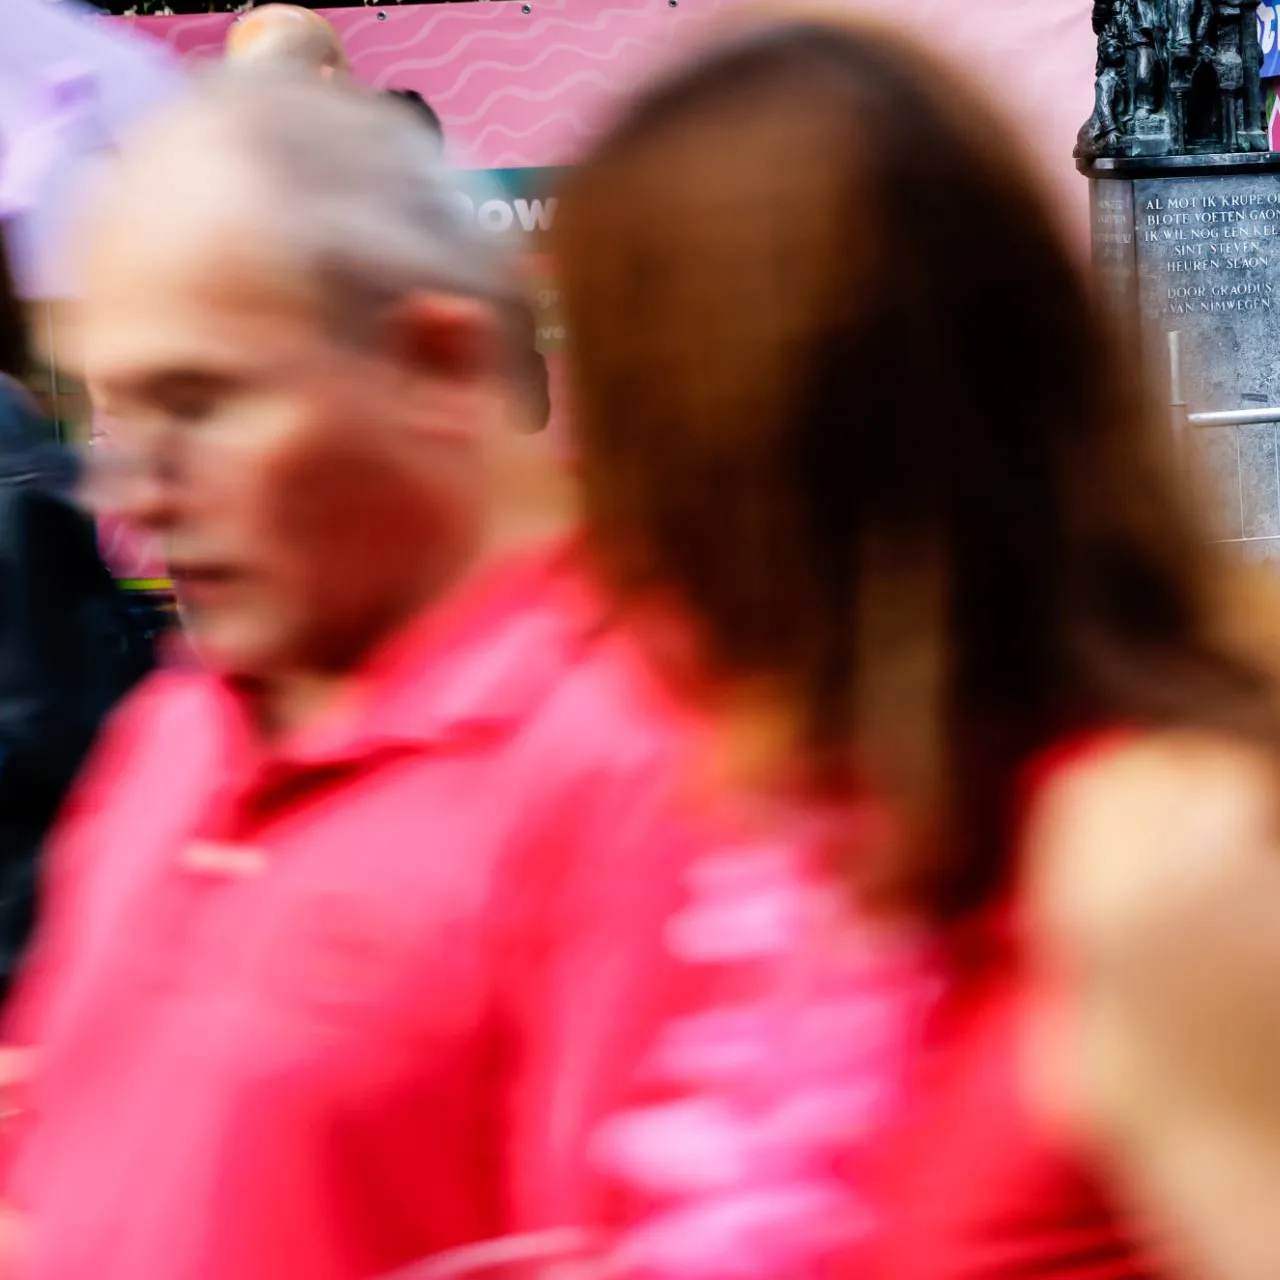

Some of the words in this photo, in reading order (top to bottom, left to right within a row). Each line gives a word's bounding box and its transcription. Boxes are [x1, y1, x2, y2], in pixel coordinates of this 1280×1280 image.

[1168, 198, 1197, 209] MOT
[1202, 196, 1216, 207] IK
[1222, 194, 1264, 206] KRUPE
[1145, 231, 1159, 242] IK
[1191, 228, 1219, 239] NOG
